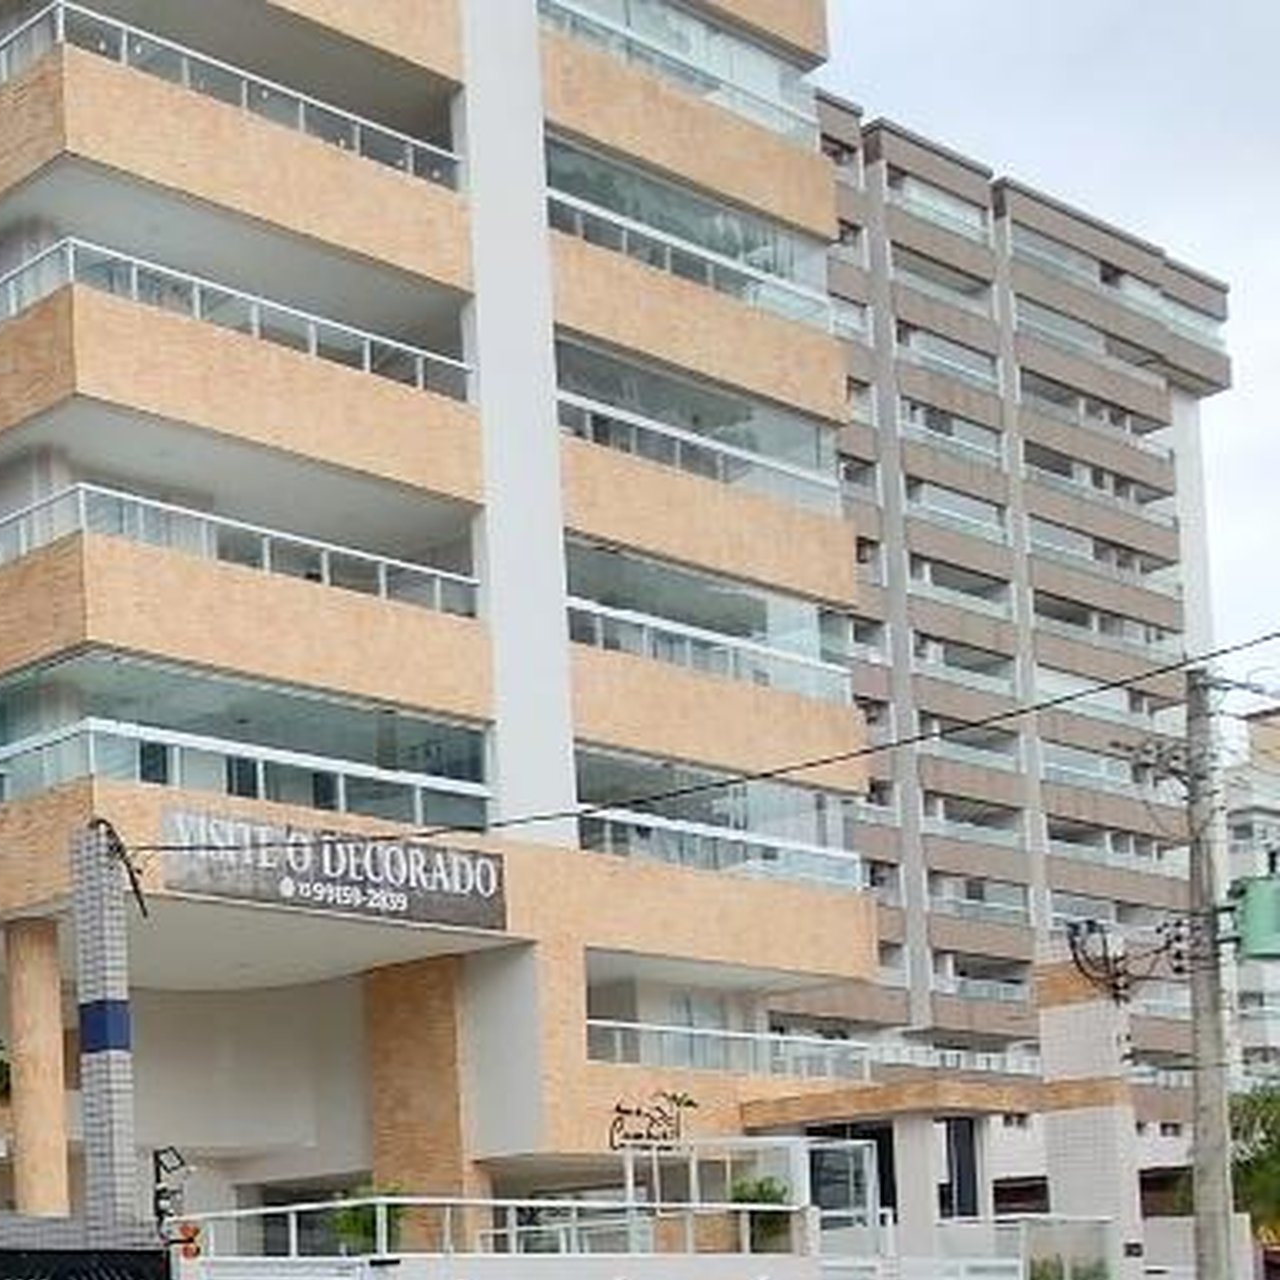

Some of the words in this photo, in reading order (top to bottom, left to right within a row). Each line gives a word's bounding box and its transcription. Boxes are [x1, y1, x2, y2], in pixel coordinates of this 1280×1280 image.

[173, 814, 277, 869] VISITE
[286, 831, 311, 873] O
[322, 836, 497, 899] DECORADO
